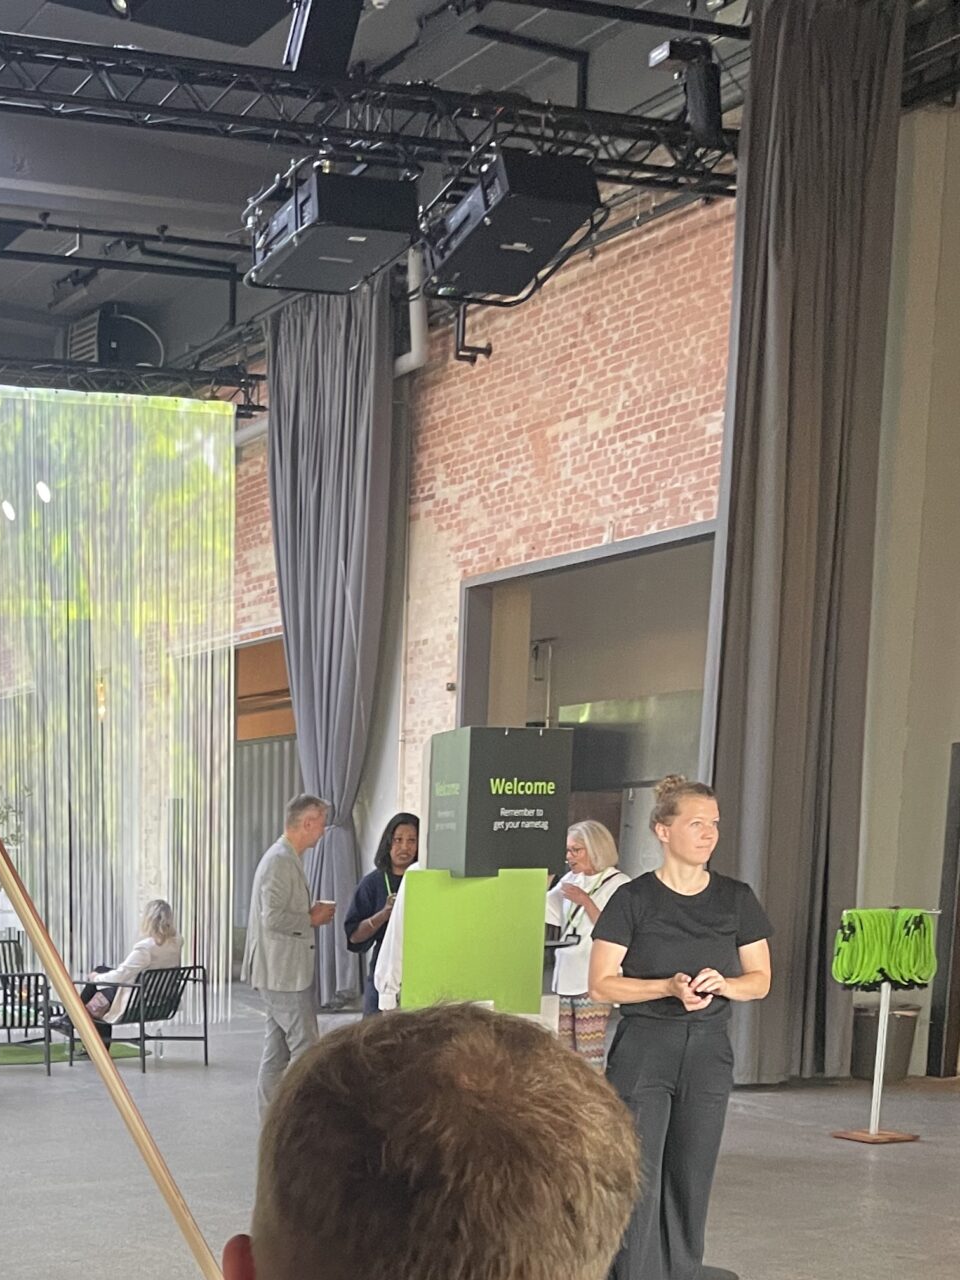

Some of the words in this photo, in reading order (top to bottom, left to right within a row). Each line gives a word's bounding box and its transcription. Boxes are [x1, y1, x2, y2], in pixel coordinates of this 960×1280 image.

[489, 777, 556, 795] Welcome
[500, 807, 536, 817] Remember
[536, 808, 544, 817] to
[492, 821, 505, 832] get
[504, 821, 521, 831] your
[520, 820, 549, 831] nametag
